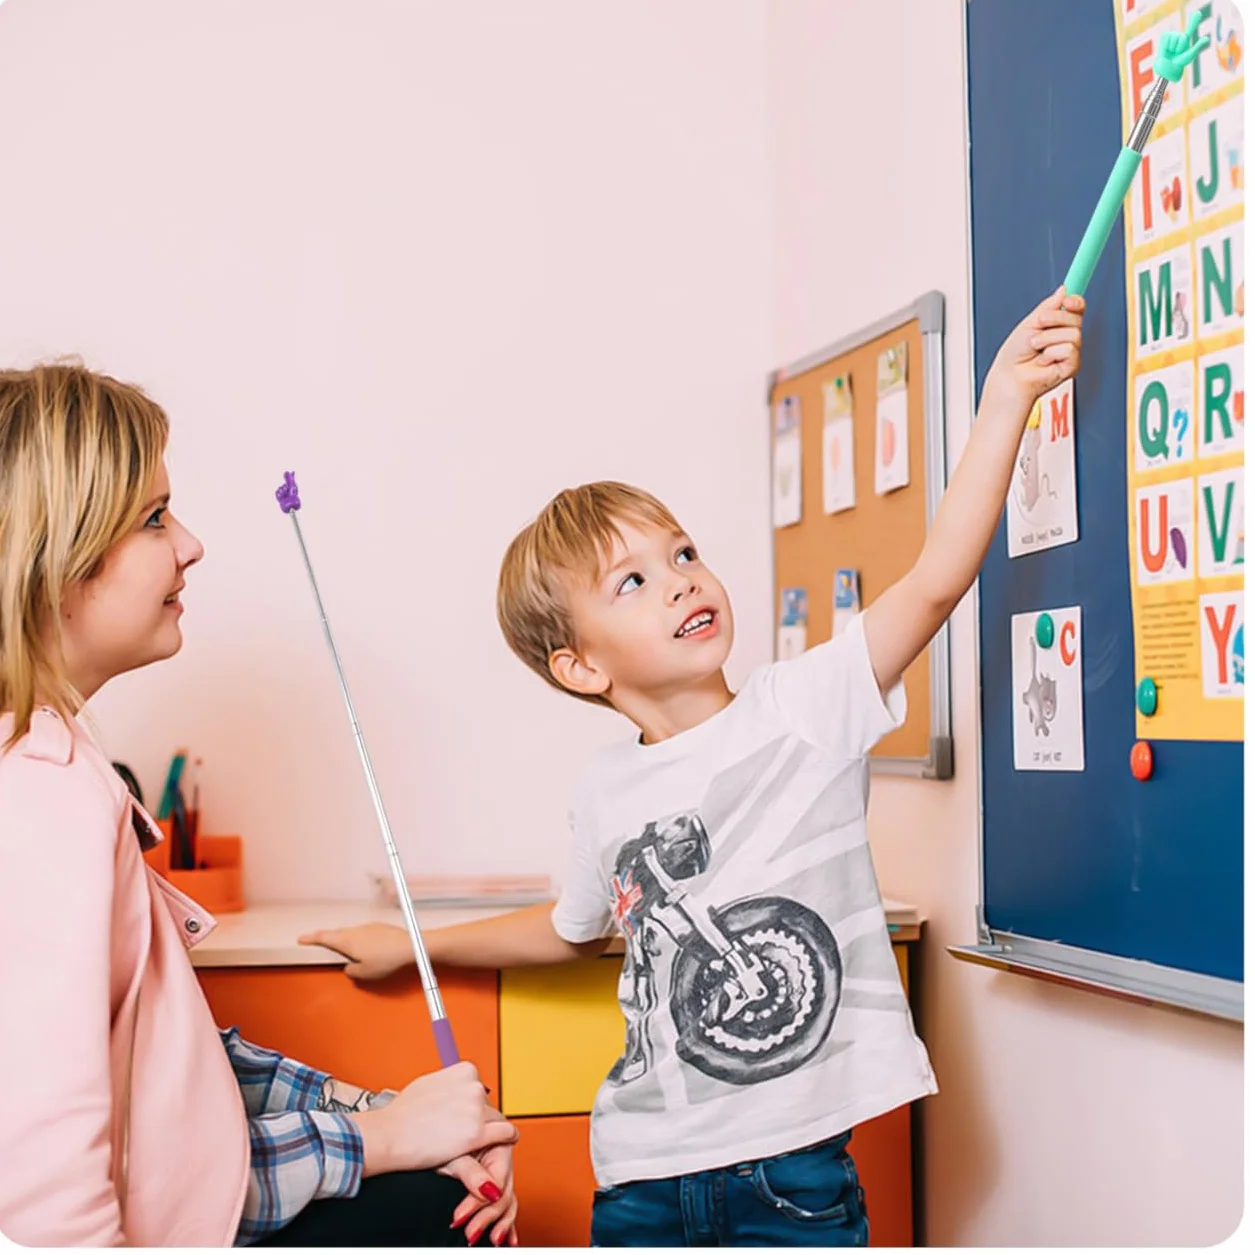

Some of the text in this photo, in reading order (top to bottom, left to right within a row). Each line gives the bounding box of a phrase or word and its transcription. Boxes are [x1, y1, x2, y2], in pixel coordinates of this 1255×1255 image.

[1140, 154, 1153, 231] I
[1196, 119, 1218, 203] J
[1138, 260, 1174, 346] M
[1201, 237, 1234, 325] N
[1050, 392, 1069, 443] M
[1139, 381, 1170, 460] Q
[1204, 362, 1234, 444] R
[1140, 495, 1168, 573] U
[1203, 481, 1235, 563] V
[1060, 620, 1077, 667] C
[1204, 604, 1237, 685] Y
